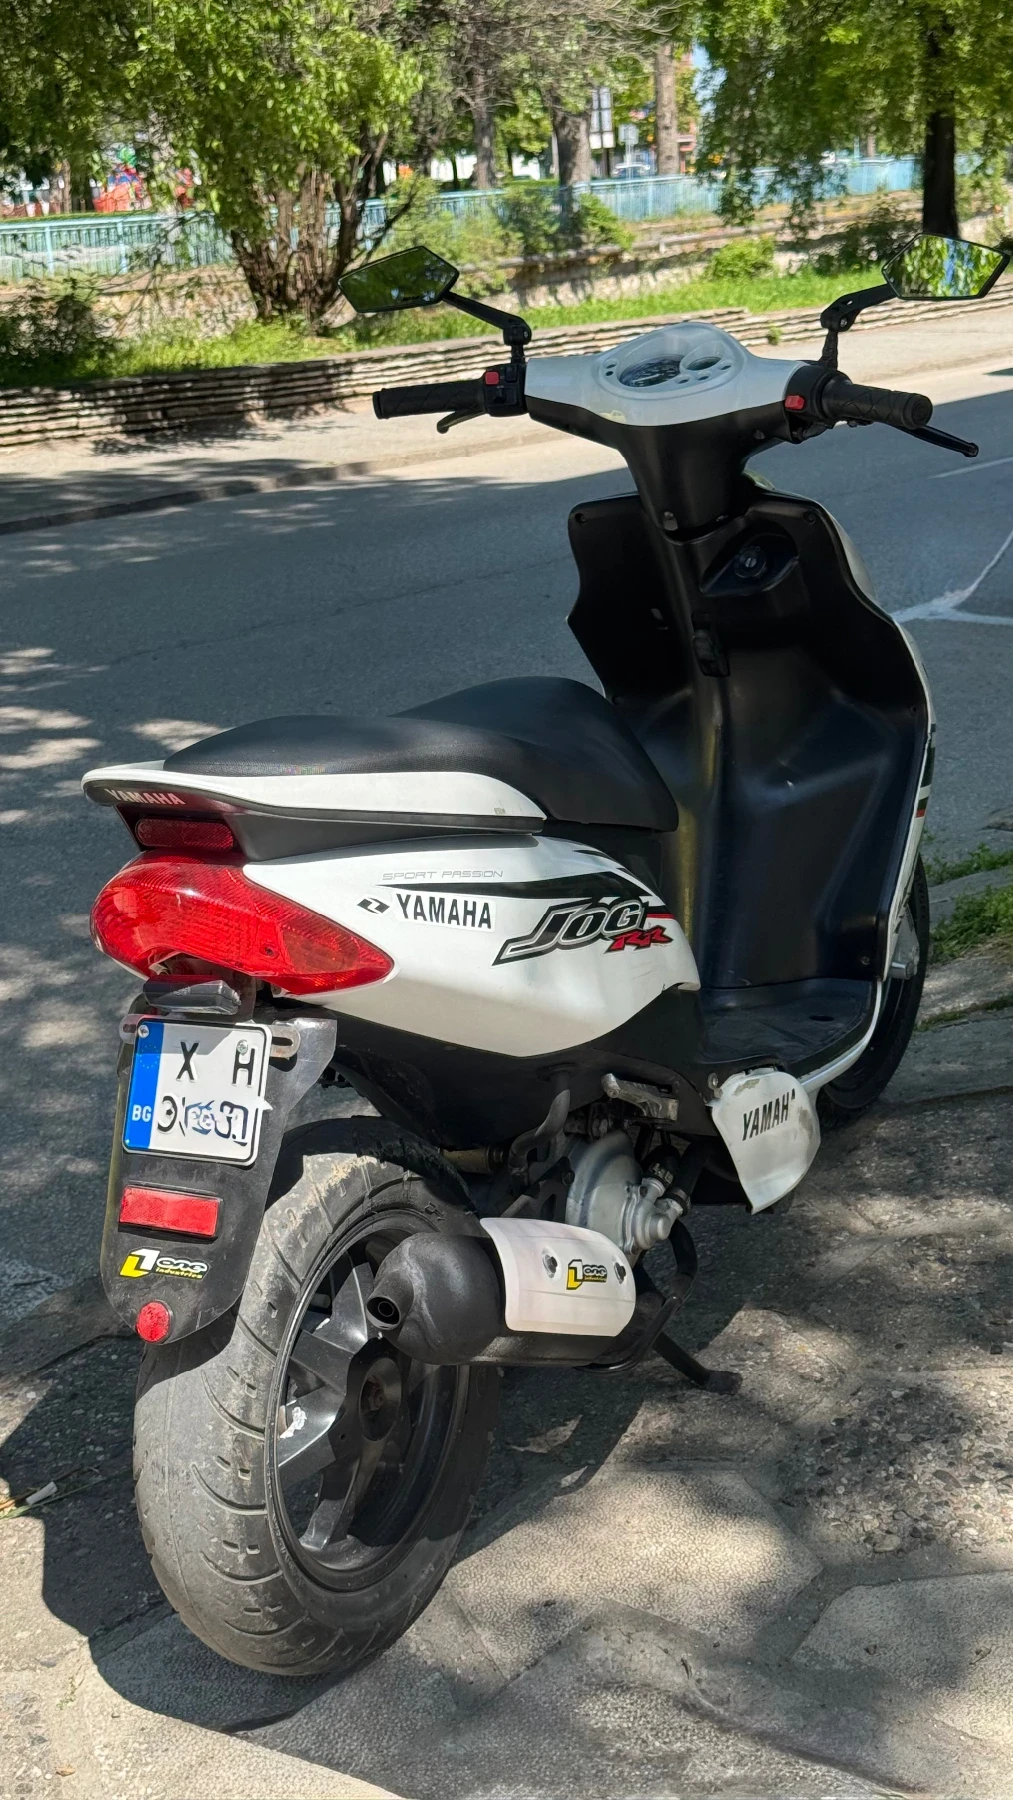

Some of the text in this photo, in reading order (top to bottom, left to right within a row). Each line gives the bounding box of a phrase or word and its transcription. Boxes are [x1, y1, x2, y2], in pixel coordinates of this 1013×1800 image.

[103, 788, 187, 805] YAMAHA
[382, 870, 504, 881] SPORT PASSION
[396, 893, 492, 929] YAMAHA
[492, 900, 645, 965] JOG
[603, 926, 673, 954] RR
[177, 1041, 256, 1086] X H
[132, 1104, 152, 1123] BG
[155, 1266, 203, 1279] industries
